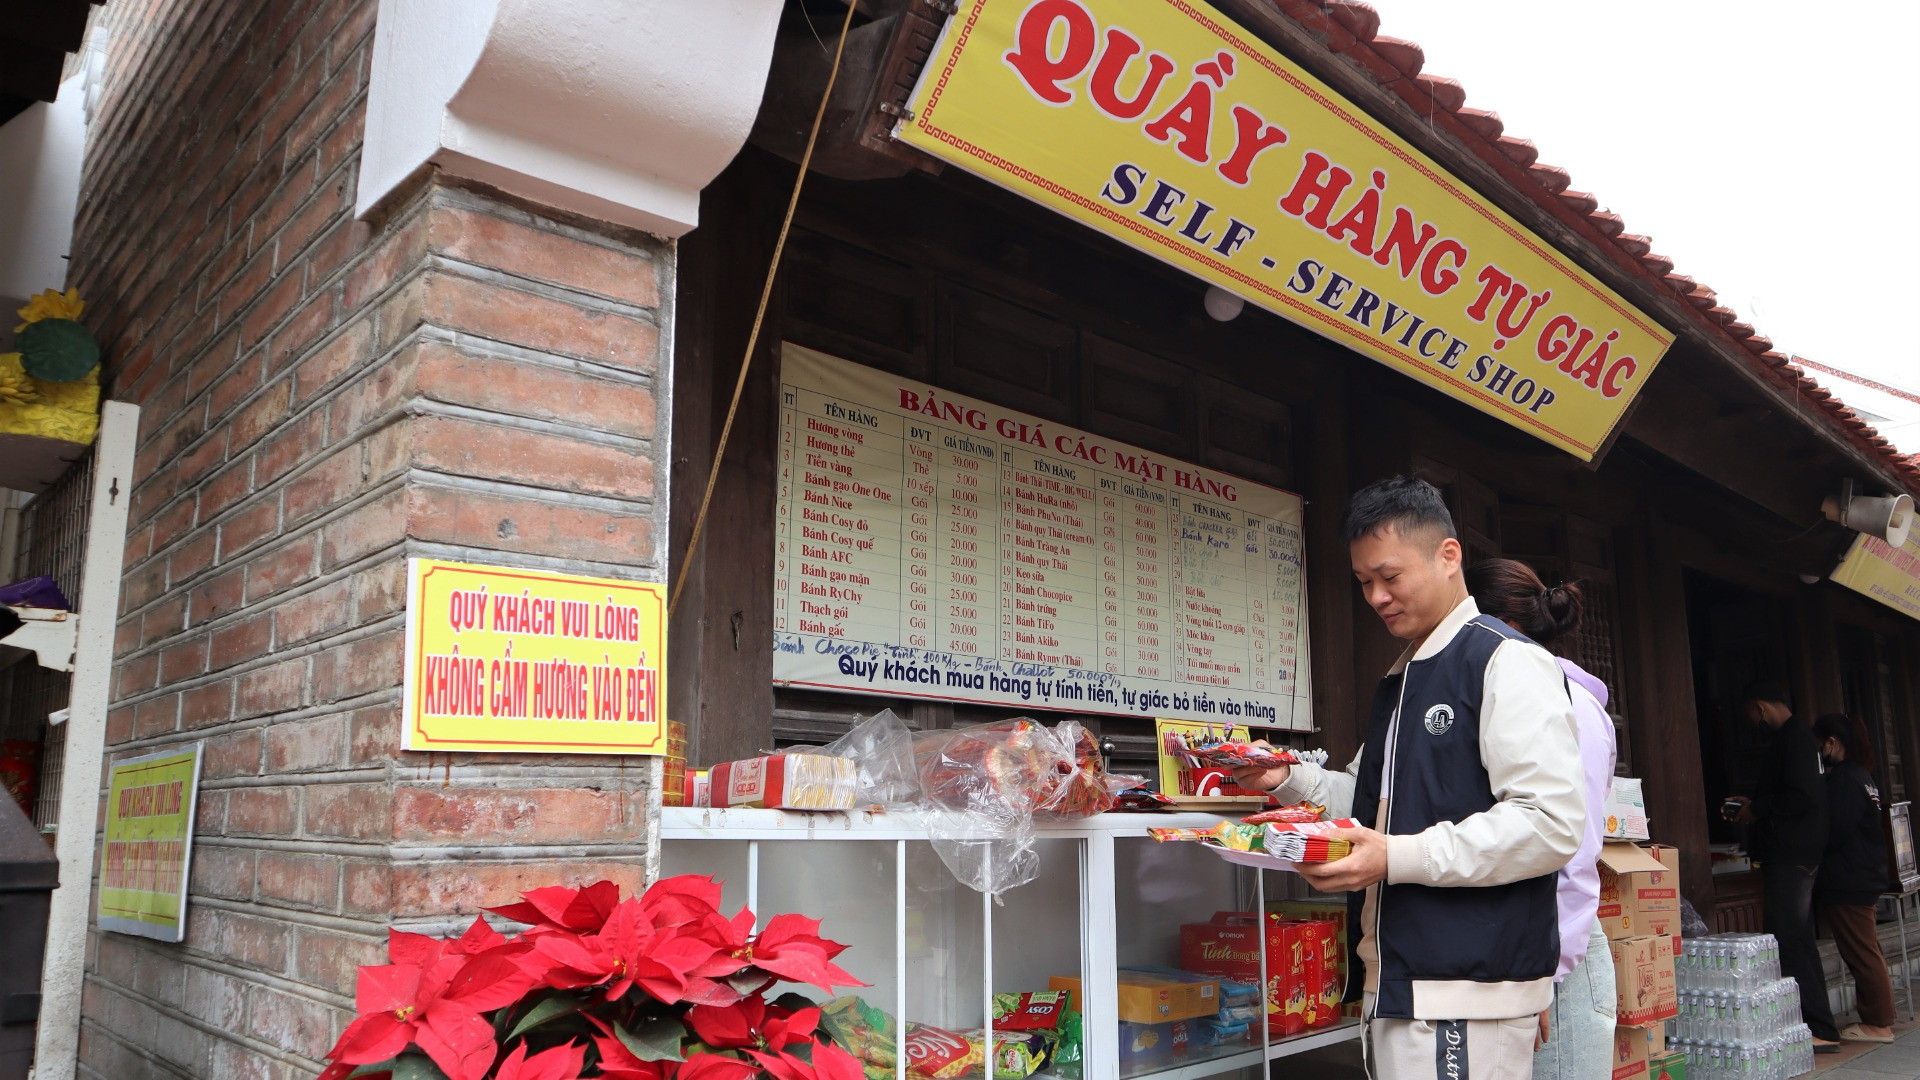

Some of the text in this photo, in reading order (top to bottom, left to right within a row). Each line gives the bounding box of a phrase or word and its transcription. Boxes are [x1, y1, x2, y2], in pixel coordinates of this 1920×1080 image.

[1003, 0, 1636, 398] QUẦY HÀNG TỰ GIÁC
[1101, 163, 1256, 258] SELF
[1287, 259, 1469, 370] SERVICE
[1466, 354, 1555, 414] SHOP
[824, 403, 878, 428] TÊN HÀNG
[808, 418, 864, 444] Hương vòng
[910, 426, 932, 442] ĐVT
[807, 436, 856, 458] Hương thẻ
[898, 387, 1237, 502] BẢNG GIÁ CÁC MẶT HÀNG
[910, 444, 933, 462] Vòng
[806, 453, 852, 478] Tiền vàng
[913, 461, 930, 475] Thẻ
[952, 455, 979, 471] 30.000
[1034, 459, 1076, 480] TÊN HÀNG
[804, 472, 892, 501] Bánh gạo One One
[907, 478, 935, 496] 10 xếp
[956, 473, 978, 487] 5.000
[1100, 478, 1117, 491] ĐVT
[804, 490, 853, 510] Bánh Nice
[911, 496, 928, 509] Gói
[952, 488, 978, 503] 10.000
[1015, 487, 1034, 501] Bánh
[1037, 492, 1058, 507] HuRa
[951, 505, 978, 519] 25.000
[1016, 503, 1035, 517] Bánh
[1192, 502, 1232, 521] TÊN HÀNG
[803, 508, 869, 531] Bánh Cosy đỏ
[911, 513, 928, 526] Gói
[910, 530, 927, 543] Gói
[950, 521, 977, 536] 25.000
[802, 526, 875, 551] Bánh Cosy quế
[950, 538, 977, 552] 20.000
[1016, 535, 1034, 549] Bánh
[1060, 545, 1071, 556] An
[802, 544, 853, 564] Bánh AFC
[910, 547, 927, 560] Gói
[950, 555, 977, 569] 20.000
[801, 563, 870, 587] Bánh gạo mặn
[910, 564, 927, 577] Gói
[1016, 567, 1030, 581] Kẹo
[950, 572, 977, 586] 30.000
[801, 582, 862, 604] Bánh RyChy
[910, 582, 927, 594] Gói
[950, 588, 977, 602] 25.000
[1016, 583, 1035, 596] Bánh
[450, 585, 638, 642] QUÝ KHÁCH VUI LÒNG
[800, 600, 848, 620] Thạch gói
[910, 599, 927, 612] Gói
[950, 606, 977, 619] 25.000
[1016, 598, 1057, 617] Bánh trứng
[800, 620, 845, 637] Bánh gấc
[910, 617, 926, 629] Gói
[950, 622, 977, 637] 20.000
[1016, 615, 1054, 631] Bánh TiFo
[909, 634, 926, 647] Gói
[950, 640, 977, 654] 45.000
[1016, 632, 1059, 648] Bánh Akiko
[1016, 648, 1035, 661] Bánh
[424, 640, 656, 722] KHÔNG CẦM HƯƠNG VÀO ĐỀN
[838, 654, 879, 682] Quý
[883, 659, 940, 685] khách
[946, 671, 984, 690] mua
[990, 671, 1031, 700] hàng
[1036, 677, 1053, 702] tự
[1056, 678, 1083, 700] tính
[1088, 680, 1118, 707] tiền,
[1122, 687, 1137, 710] tự
[1139, 689, 1170, 711] giác
[1174, 692, 1190, 711] bỏ
[1193, 691, 1216, 714] tiền
[1219, 698, 1241, 716] vào
[1244, 698, 1276, 723] thùng
